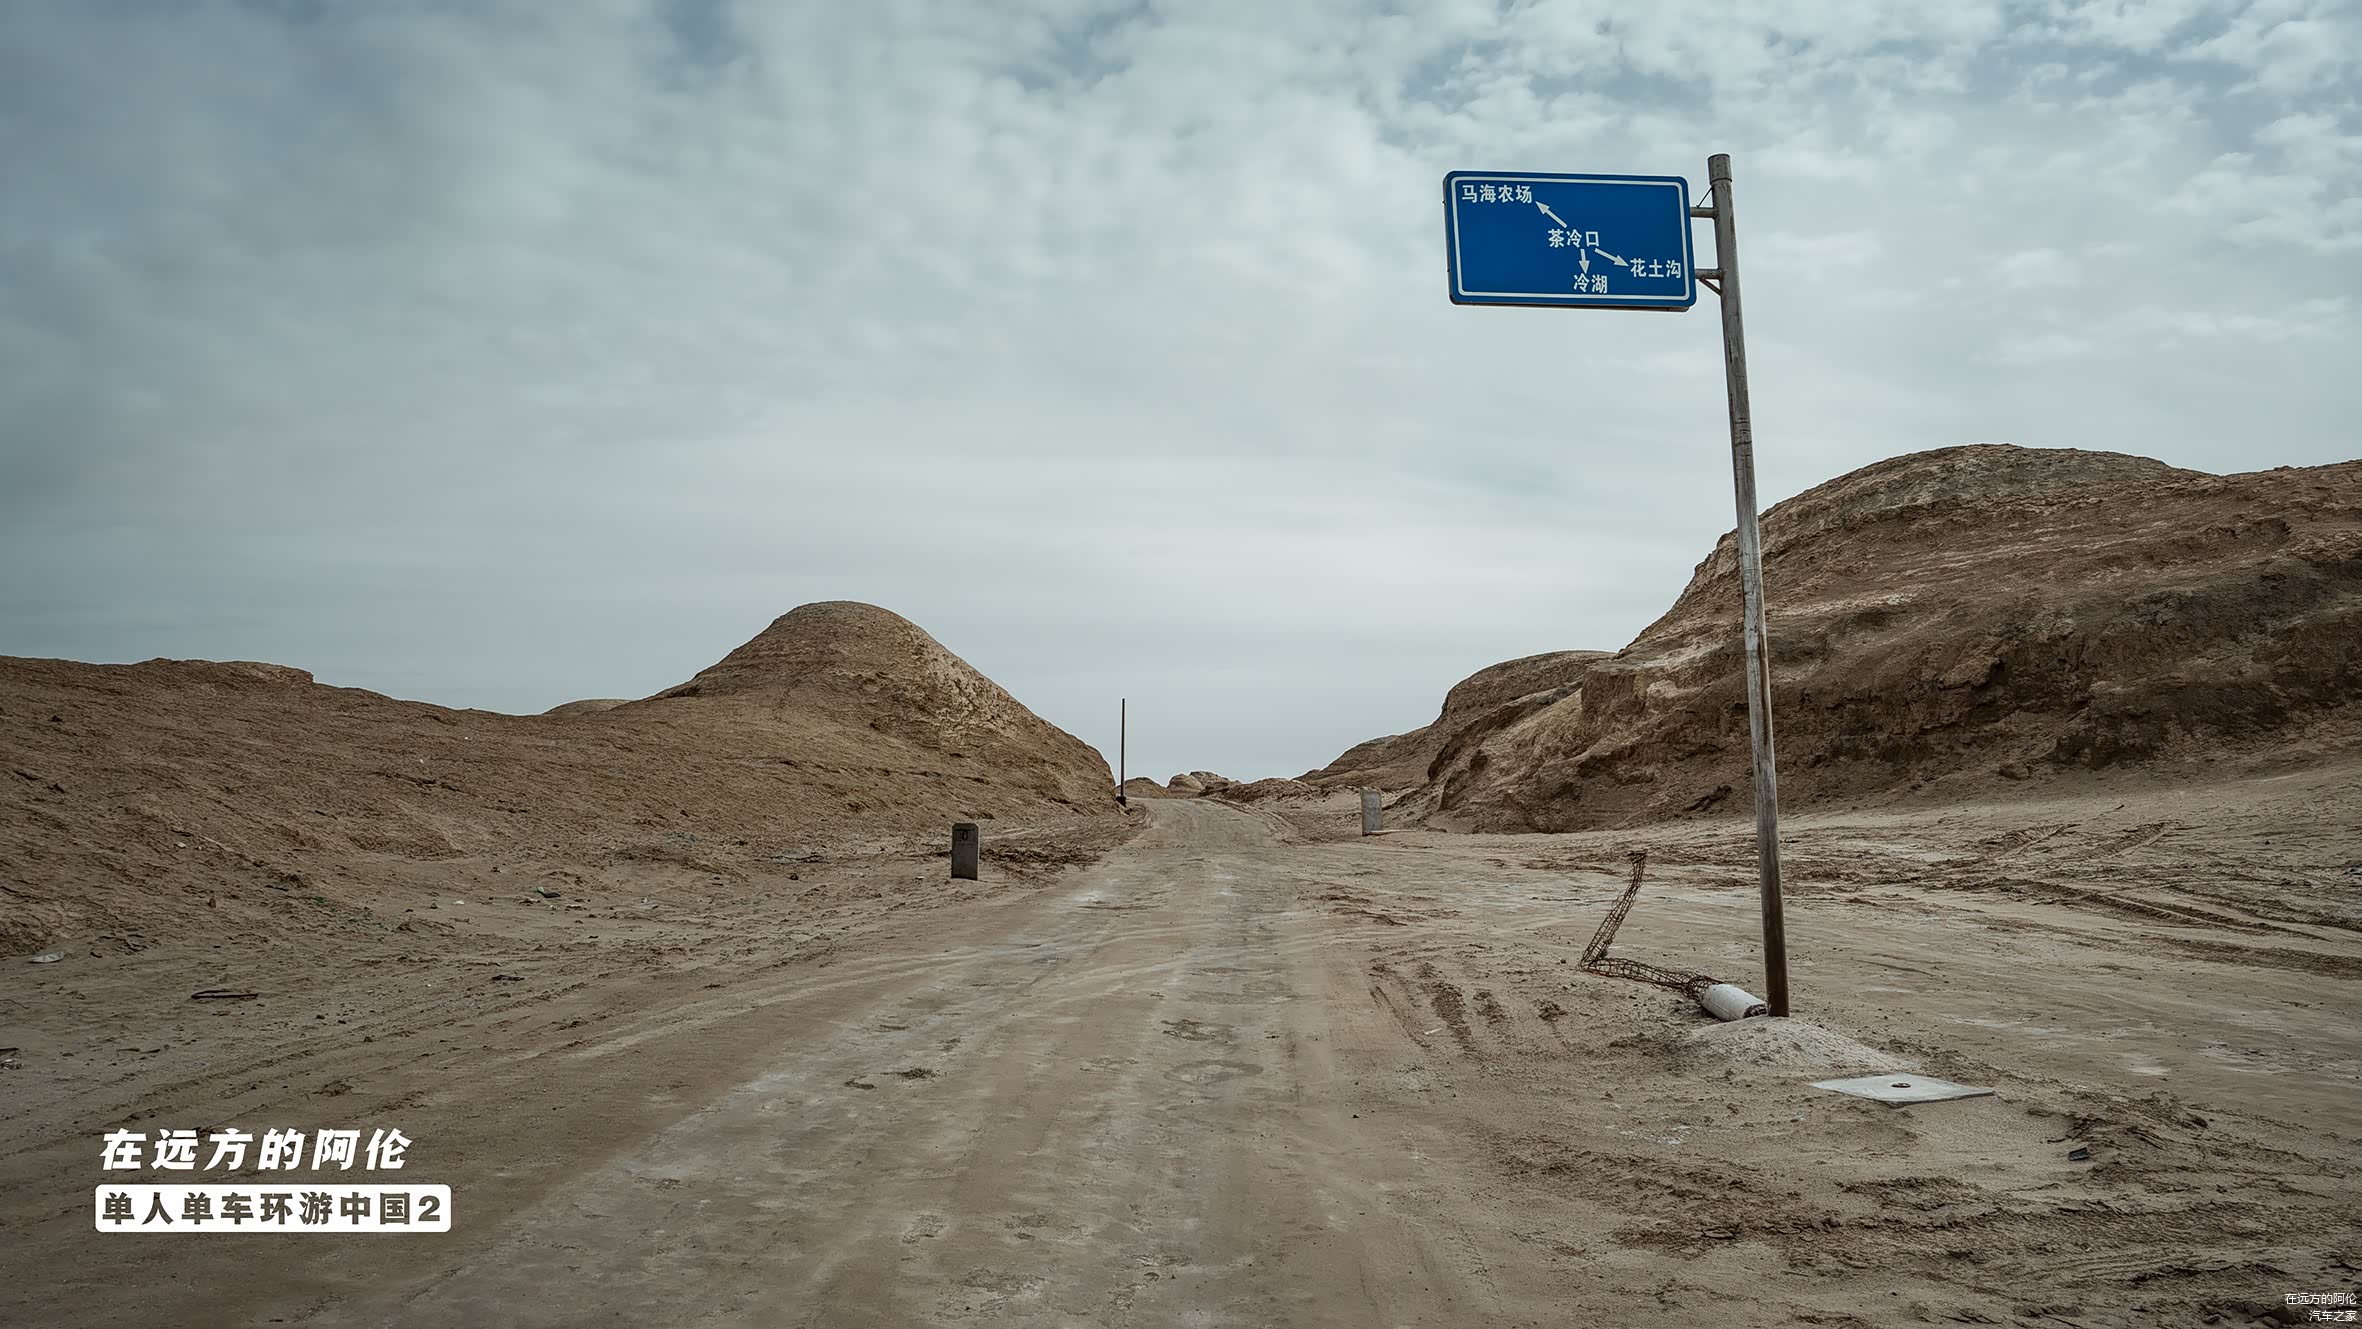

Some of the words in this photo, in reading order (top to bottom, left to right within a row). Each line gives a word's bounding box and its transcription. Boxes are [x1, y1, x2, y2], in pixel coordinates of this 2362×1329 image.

[1462, 184, 1532, 204] 马海农场
[1548, 229, 1600, 248] 茶冷口
[1630, 258, 1682, 278] 花土沟
[1573, 274, 1608, 294] 冷湖
